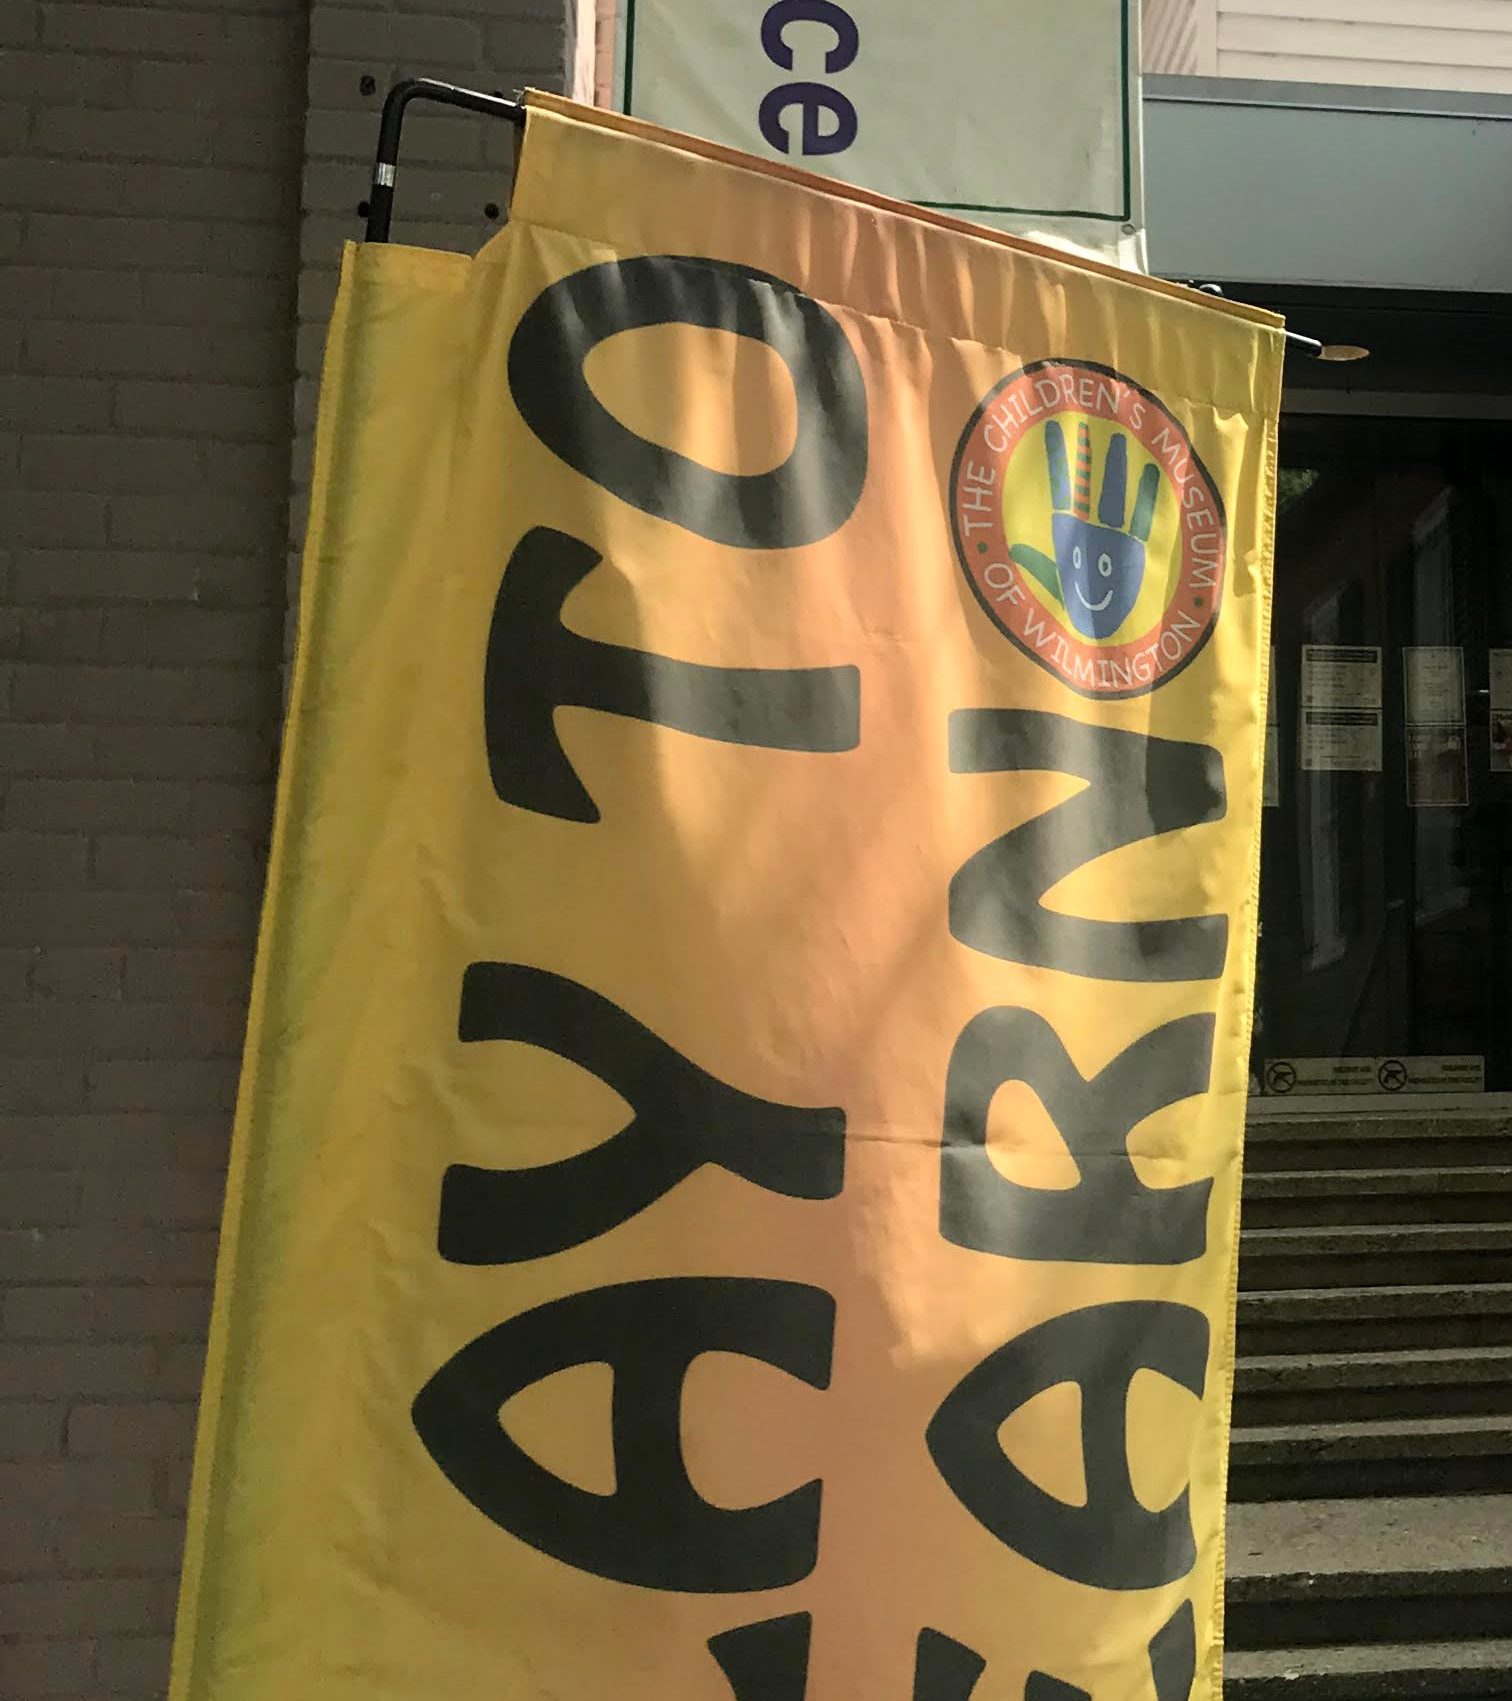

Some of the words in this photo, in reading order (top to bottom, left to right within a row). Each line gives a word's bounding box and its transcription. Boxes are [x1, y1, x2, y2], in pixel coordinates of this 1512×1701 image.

[759, 0, 859, 156] ce
[485, 255, 868, 823] TO
[963, 461, 996, 536] THE
[984, 374, 1146, 453] CHILDREN'S
[1152, 428, 1216, 588] MUSEUM
[984, 563, 1025, 605] OF
[1023, 611, 1200, 688] WILMINGTON
[411, 960, 846, 1701] AY
